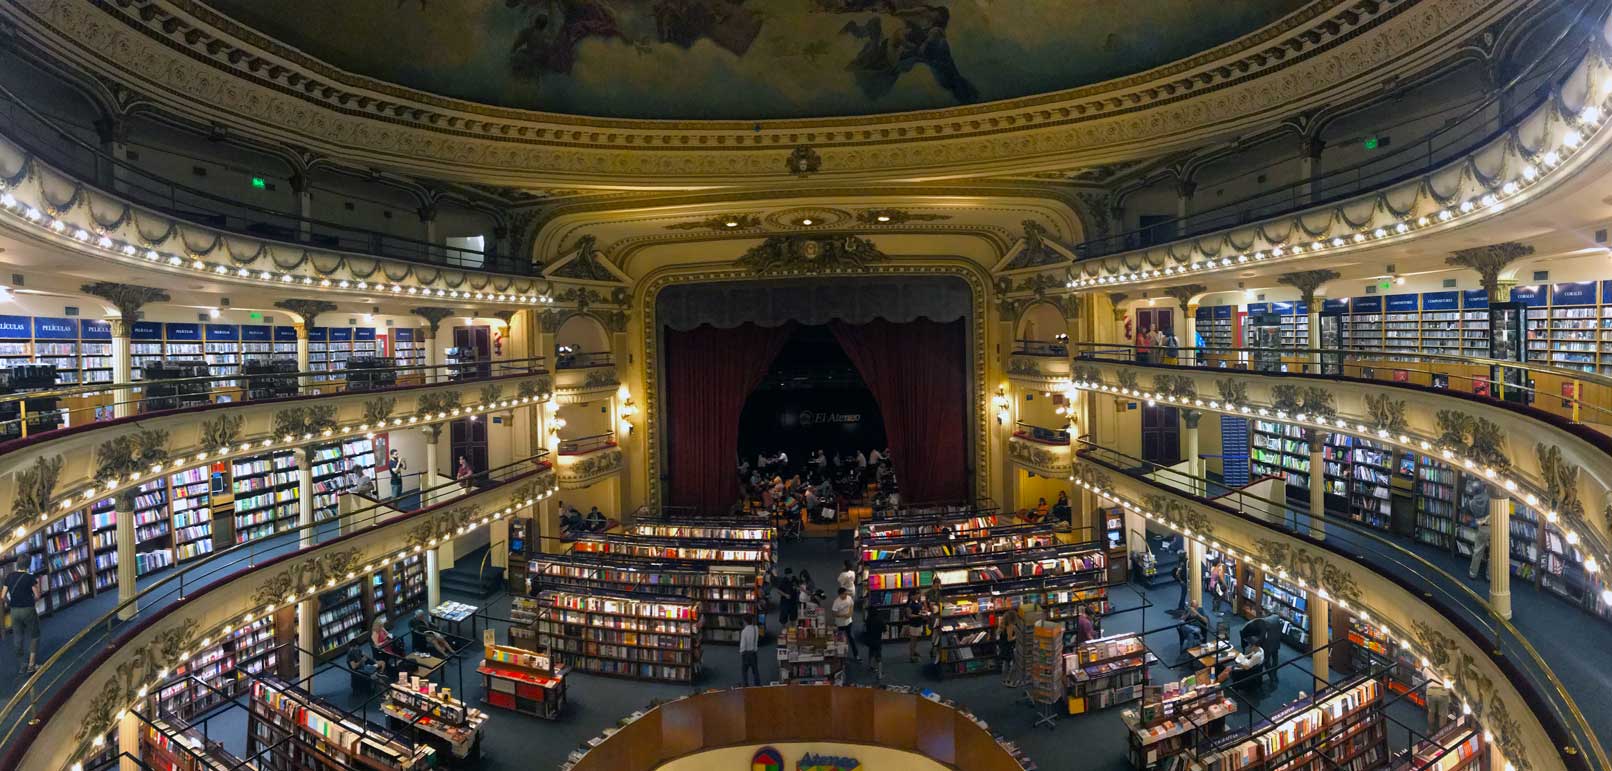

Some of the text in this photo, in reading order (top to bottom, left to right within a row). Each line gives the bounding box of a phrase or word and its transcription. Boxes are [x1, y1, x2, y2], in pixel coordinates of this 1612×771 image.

[0, 322, 24, 330] LÍCULAS
[814, 413, 861, 423] El Ateneo
